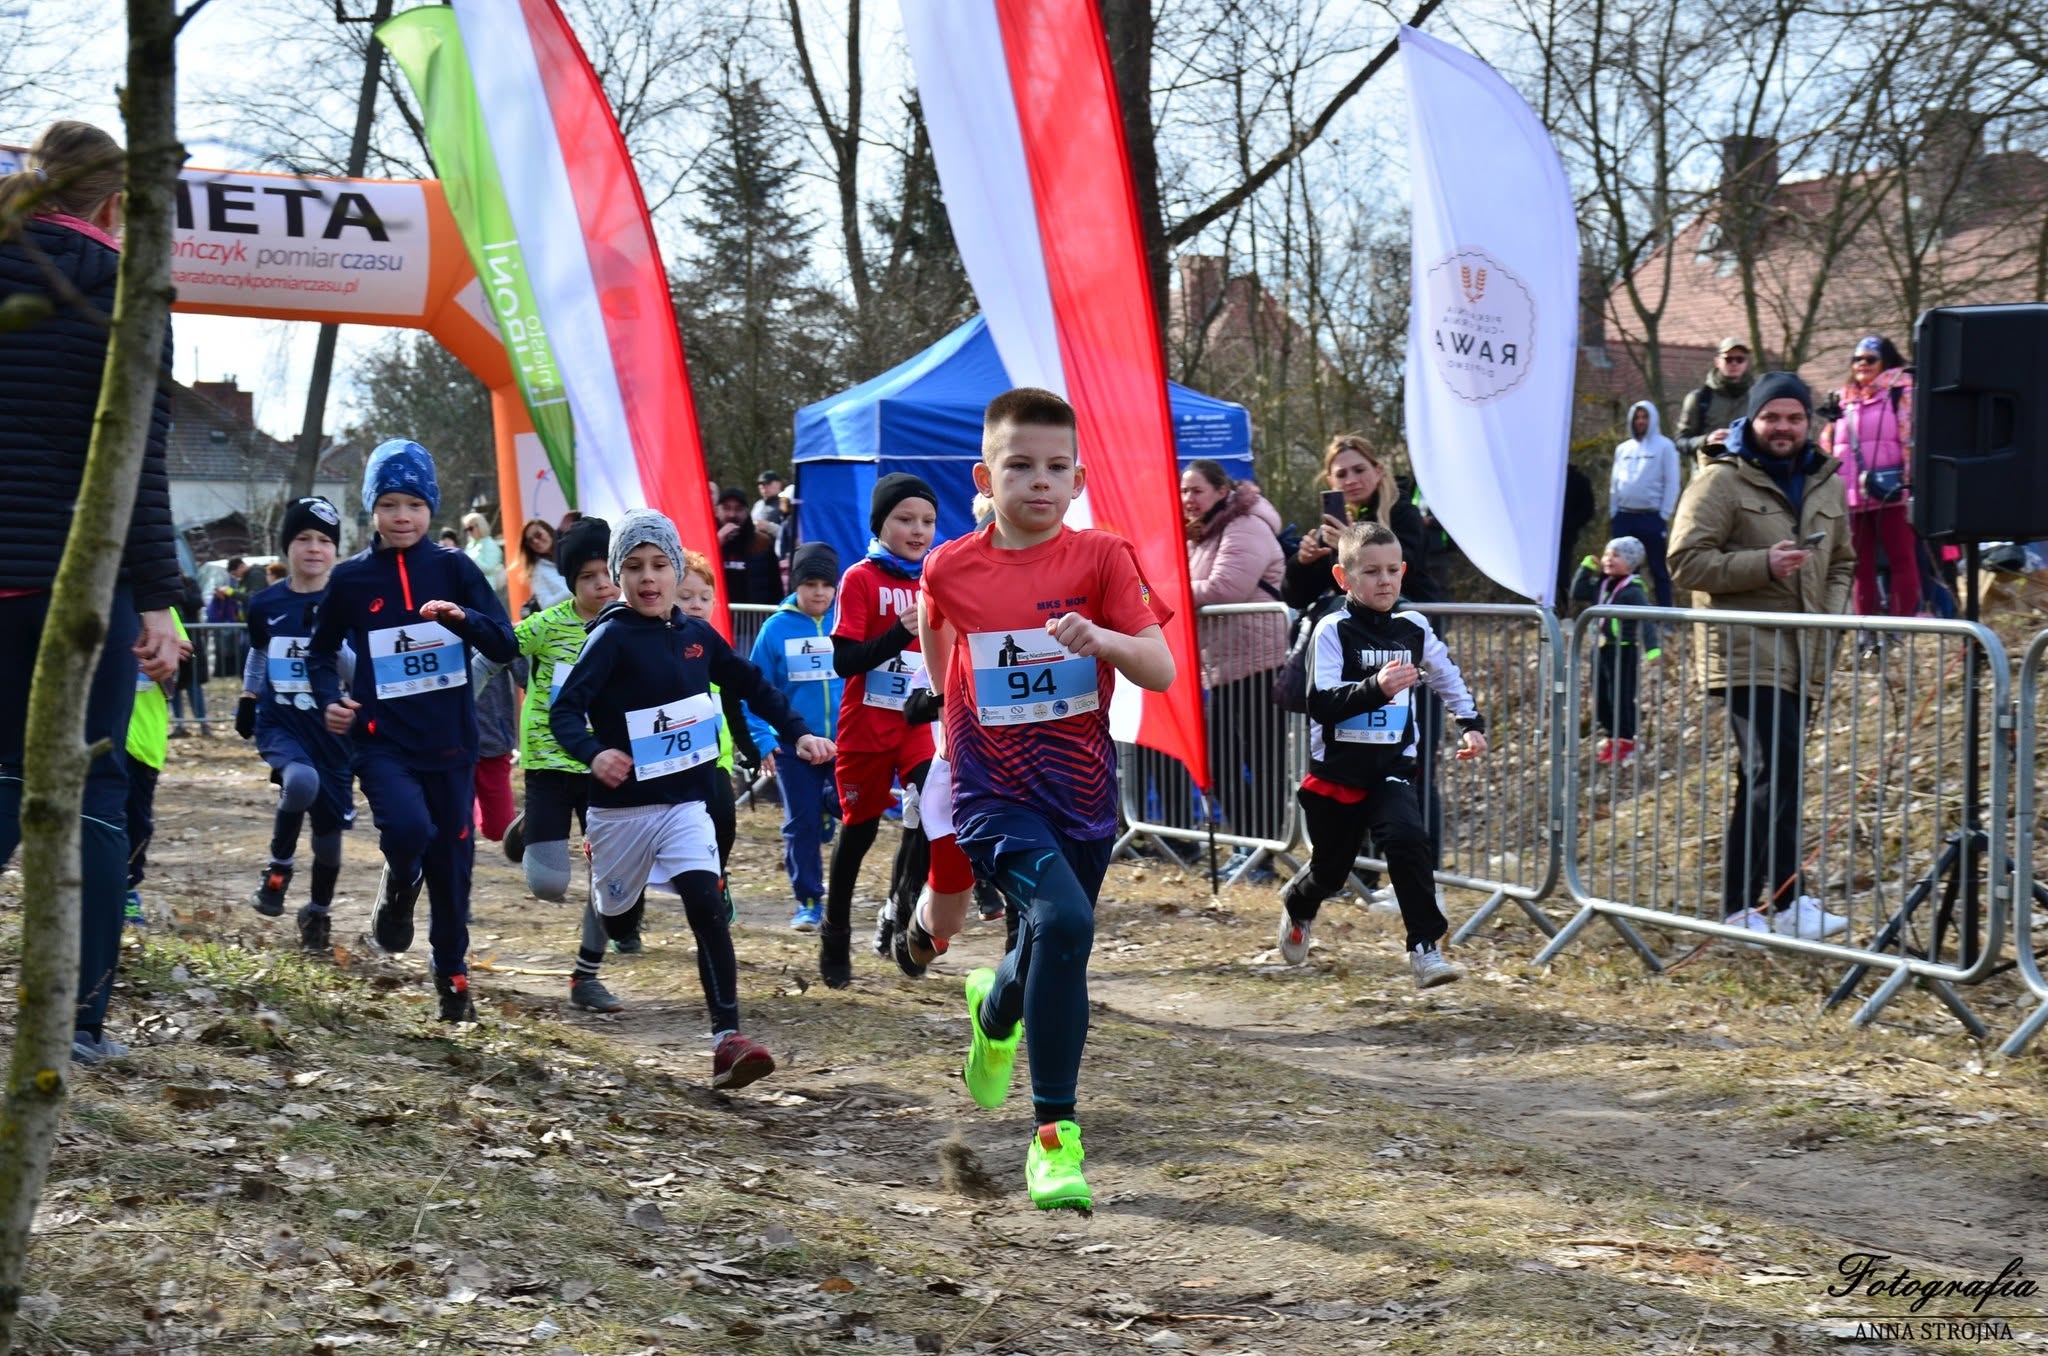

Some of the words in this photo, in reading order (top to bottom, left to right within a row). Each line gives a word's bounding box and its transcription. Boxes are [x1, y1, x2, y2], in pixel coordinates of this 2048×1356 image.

[170, 235, 248, 266] ończyk
[1037, 600, 1061, 610] MKS
[1065, 597, 1087, 607] MOS
[291, 661, 308, 677] 9
[403, 652, 439, 676] 88
[811, 655, 822, 669] 5
[1007, 668, 1057, 699] 94
[1367, 709, 1387, 728] 13
[661, 730, 692, 757] 78
